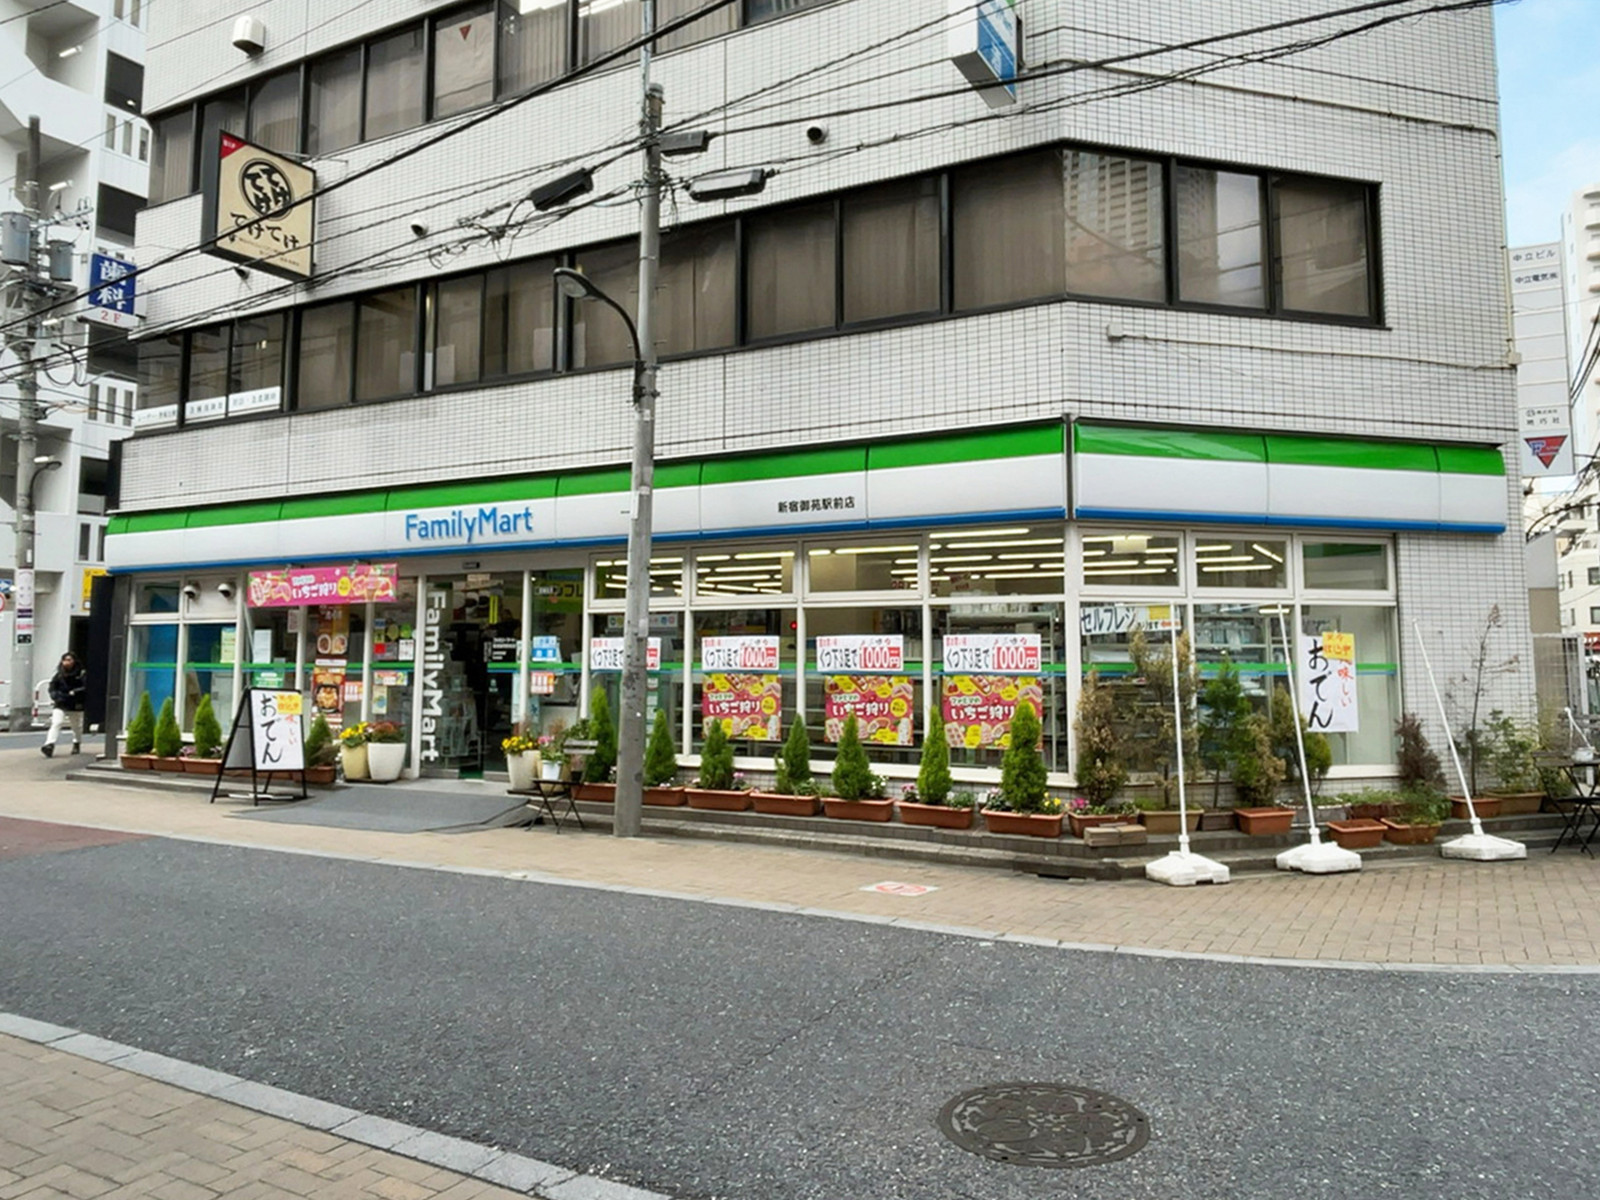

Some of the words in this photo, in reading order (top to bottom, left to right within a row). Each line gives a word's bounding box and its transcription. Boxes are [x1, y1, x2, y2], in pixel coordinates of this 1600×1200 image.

[97, 260, 128, 310] 歯科
[101, 309, 121, 324] 2F
[778, 496, 855, 513] 新宿御苑駅前店
[405, 506, 533, 542] FamilyMart
[741, 646, 777, 668] 1000円
[860, 646, 900, 668] 1000円
[992, 646, 1038, 670] 1000円
[421, 591, 446, 762] FamilyMart
[1308, 638, 1334, 729] おでん
[708, 700, 760, 714] いちご狩り
[950, 704, 1014, 720] いちご狩り
[261, 693, 284, 765] おでん
